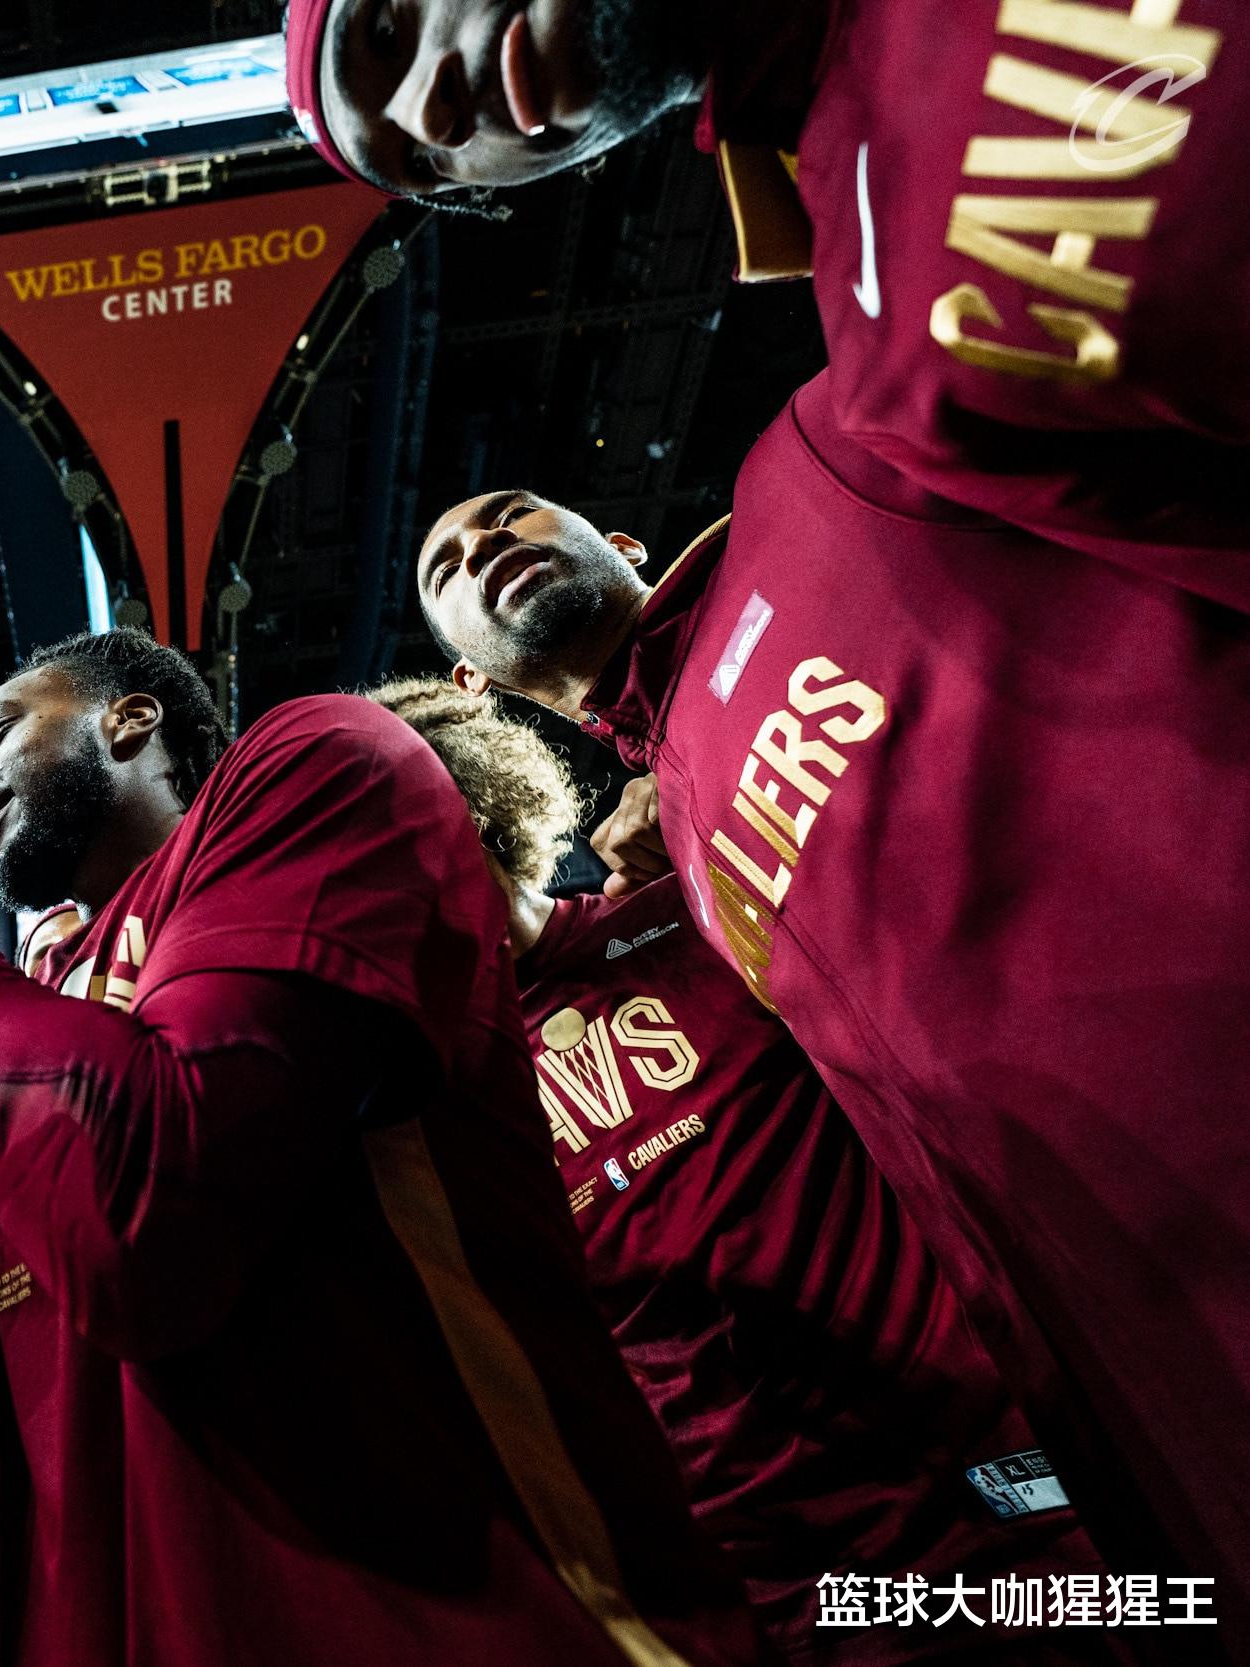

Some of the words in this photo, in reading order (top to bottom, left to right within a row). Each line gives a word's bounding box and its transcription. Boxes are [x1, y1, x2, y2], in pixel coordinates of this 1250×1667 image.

[4, 248, 163, 301] WELLS
[174, 224, 327, 279] FARGO
[101, 279, 233, 322] CENTER
[633, 926, 659, 943] AVERY
[633, 921, 680, 948] DENNISON
[628, 1114, 706, 1171] CAVALIERS
[1004, 1464, 1026, 1477] XL
